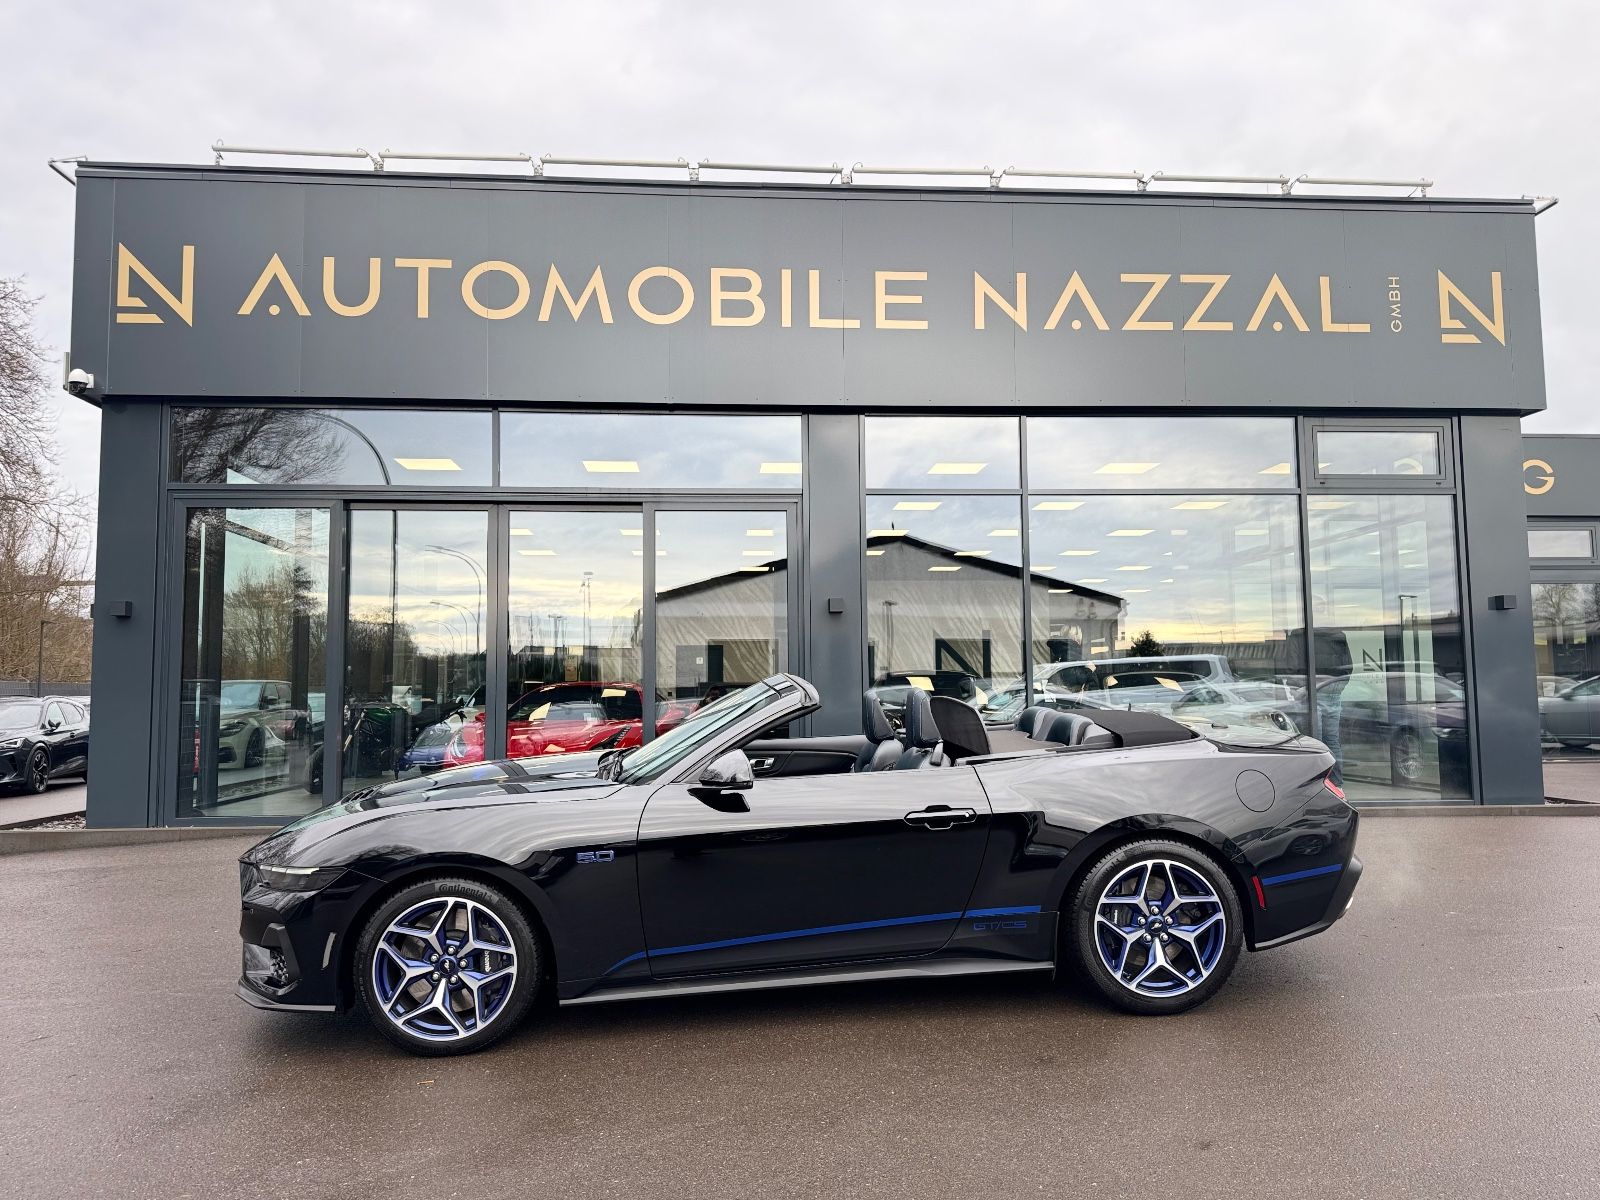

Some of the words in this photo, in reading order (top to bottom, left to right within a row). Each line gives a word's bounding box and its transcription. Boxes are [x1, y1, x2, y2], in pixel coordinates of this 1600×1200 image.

[237, 252, 930, 331] AUTOMOBILE
[974, 269, 1372, 334] NAZZAL
[1387, 276, 1403, 333] GMBH
[438, 883, 488, 900] Continental
[484, 950, 492, 973] bremb
